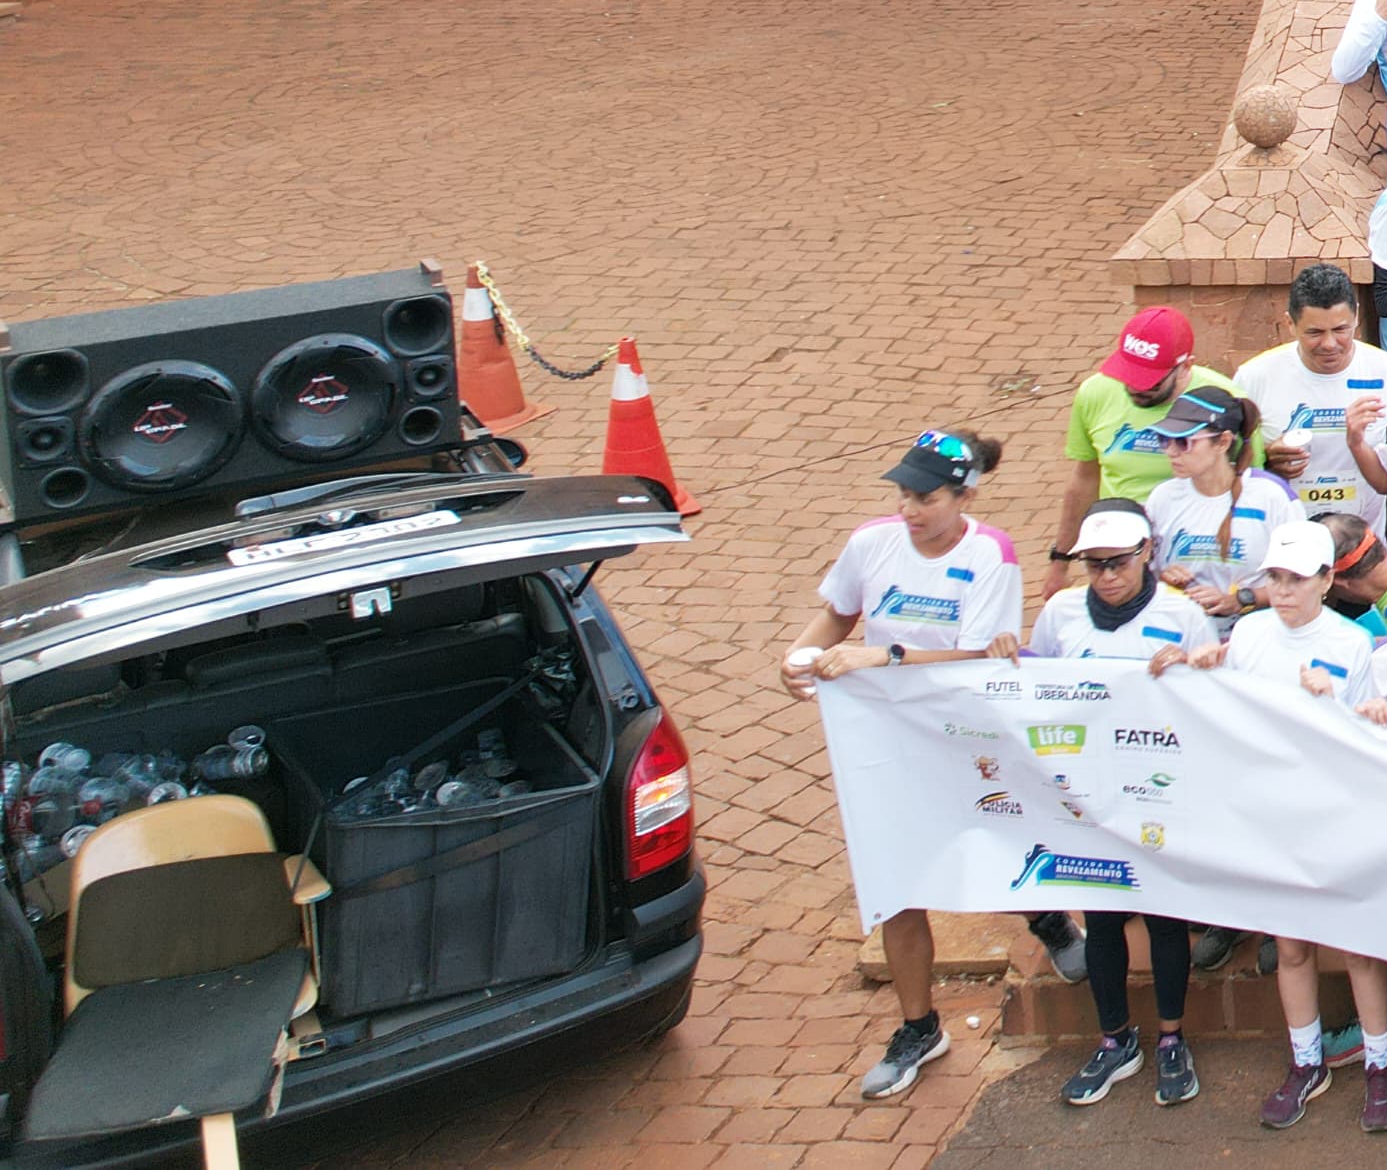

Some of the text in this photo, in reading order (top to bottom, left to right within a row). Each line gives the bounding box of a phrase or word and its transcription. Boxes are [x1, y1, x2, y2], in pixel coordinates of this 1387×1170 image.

[1308, 489, 1344, 501] 043
[986, 681, 1023, 693] FUTEL
[1039, 726, 1076, 746] life
[1115, 729, 1180, 748] FATRA
[1055, 864, 1123, 878] REVEZAMENTO
